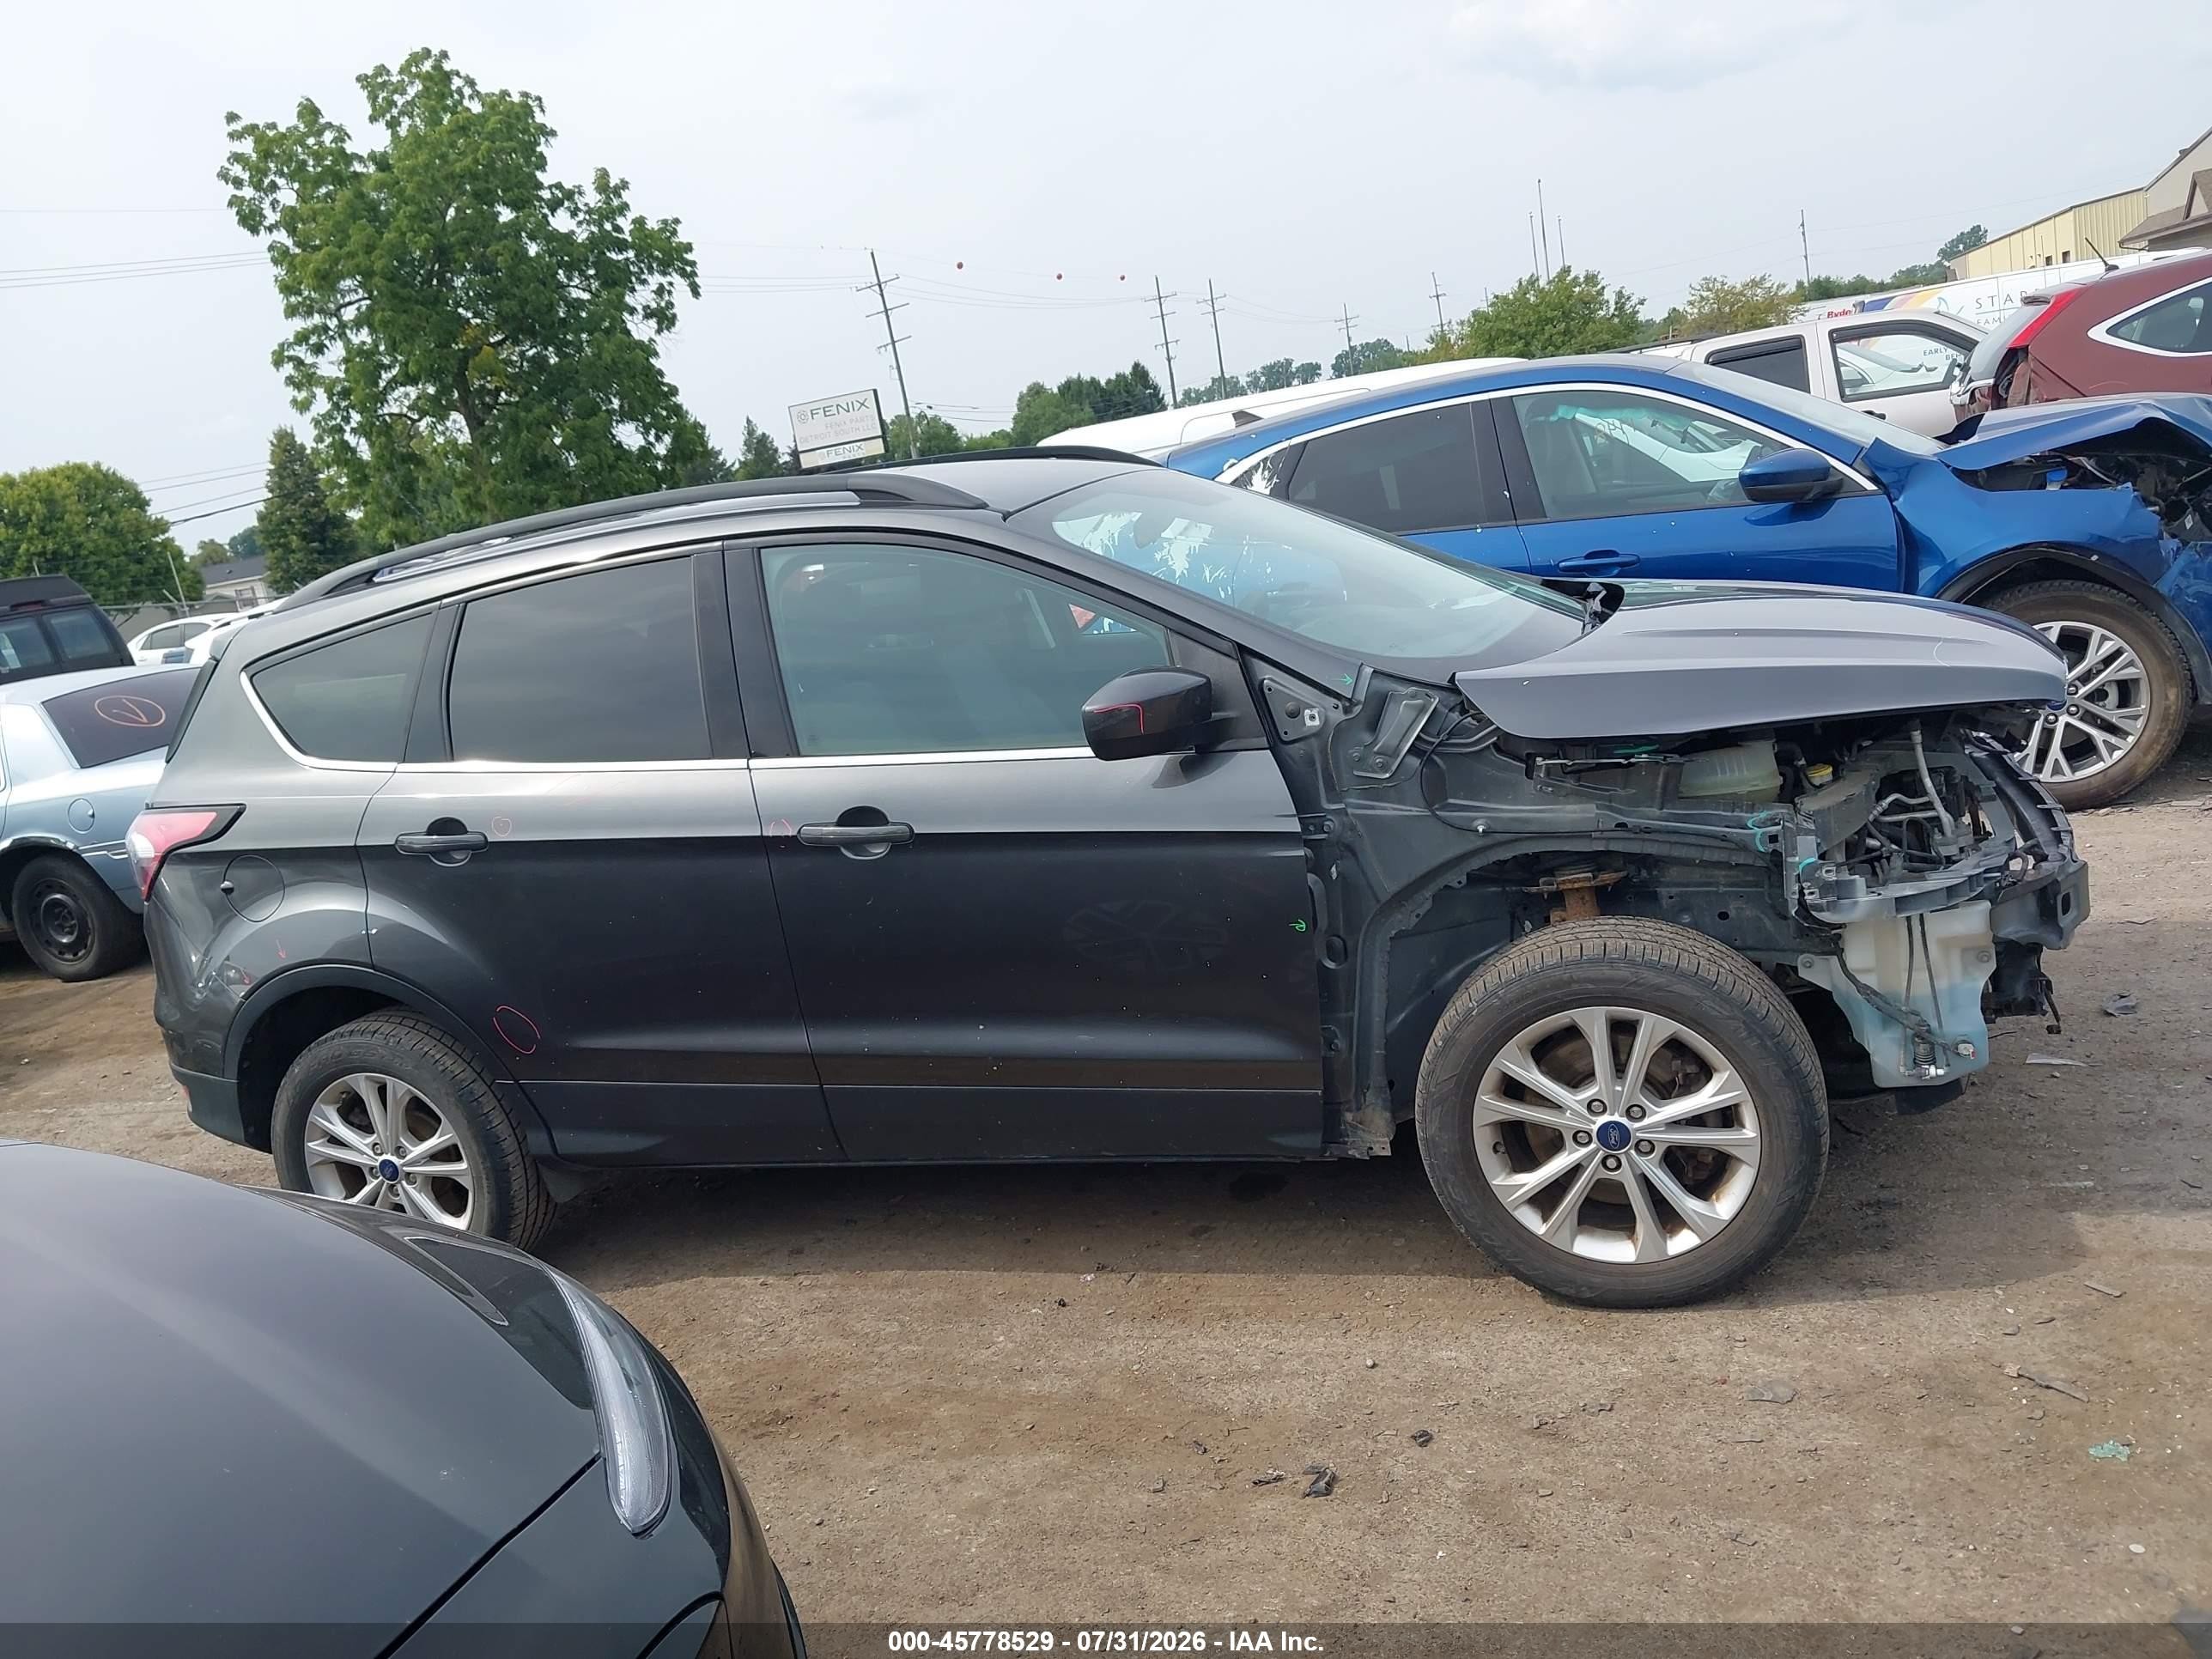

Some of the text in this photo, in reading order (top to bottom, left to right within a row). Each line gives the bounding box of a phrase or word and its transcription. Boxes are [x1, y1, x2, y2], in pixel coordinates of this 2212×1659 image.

[1923, 347, 1948, 356] EARLY
[811, 398, 870, 420] FENIX
[825, 415, 875, 429] FENIX PARTS
[799, 423, 878, 443] DETROIT SOUTH LLC
[826, 443, 865, 458] FENIX
